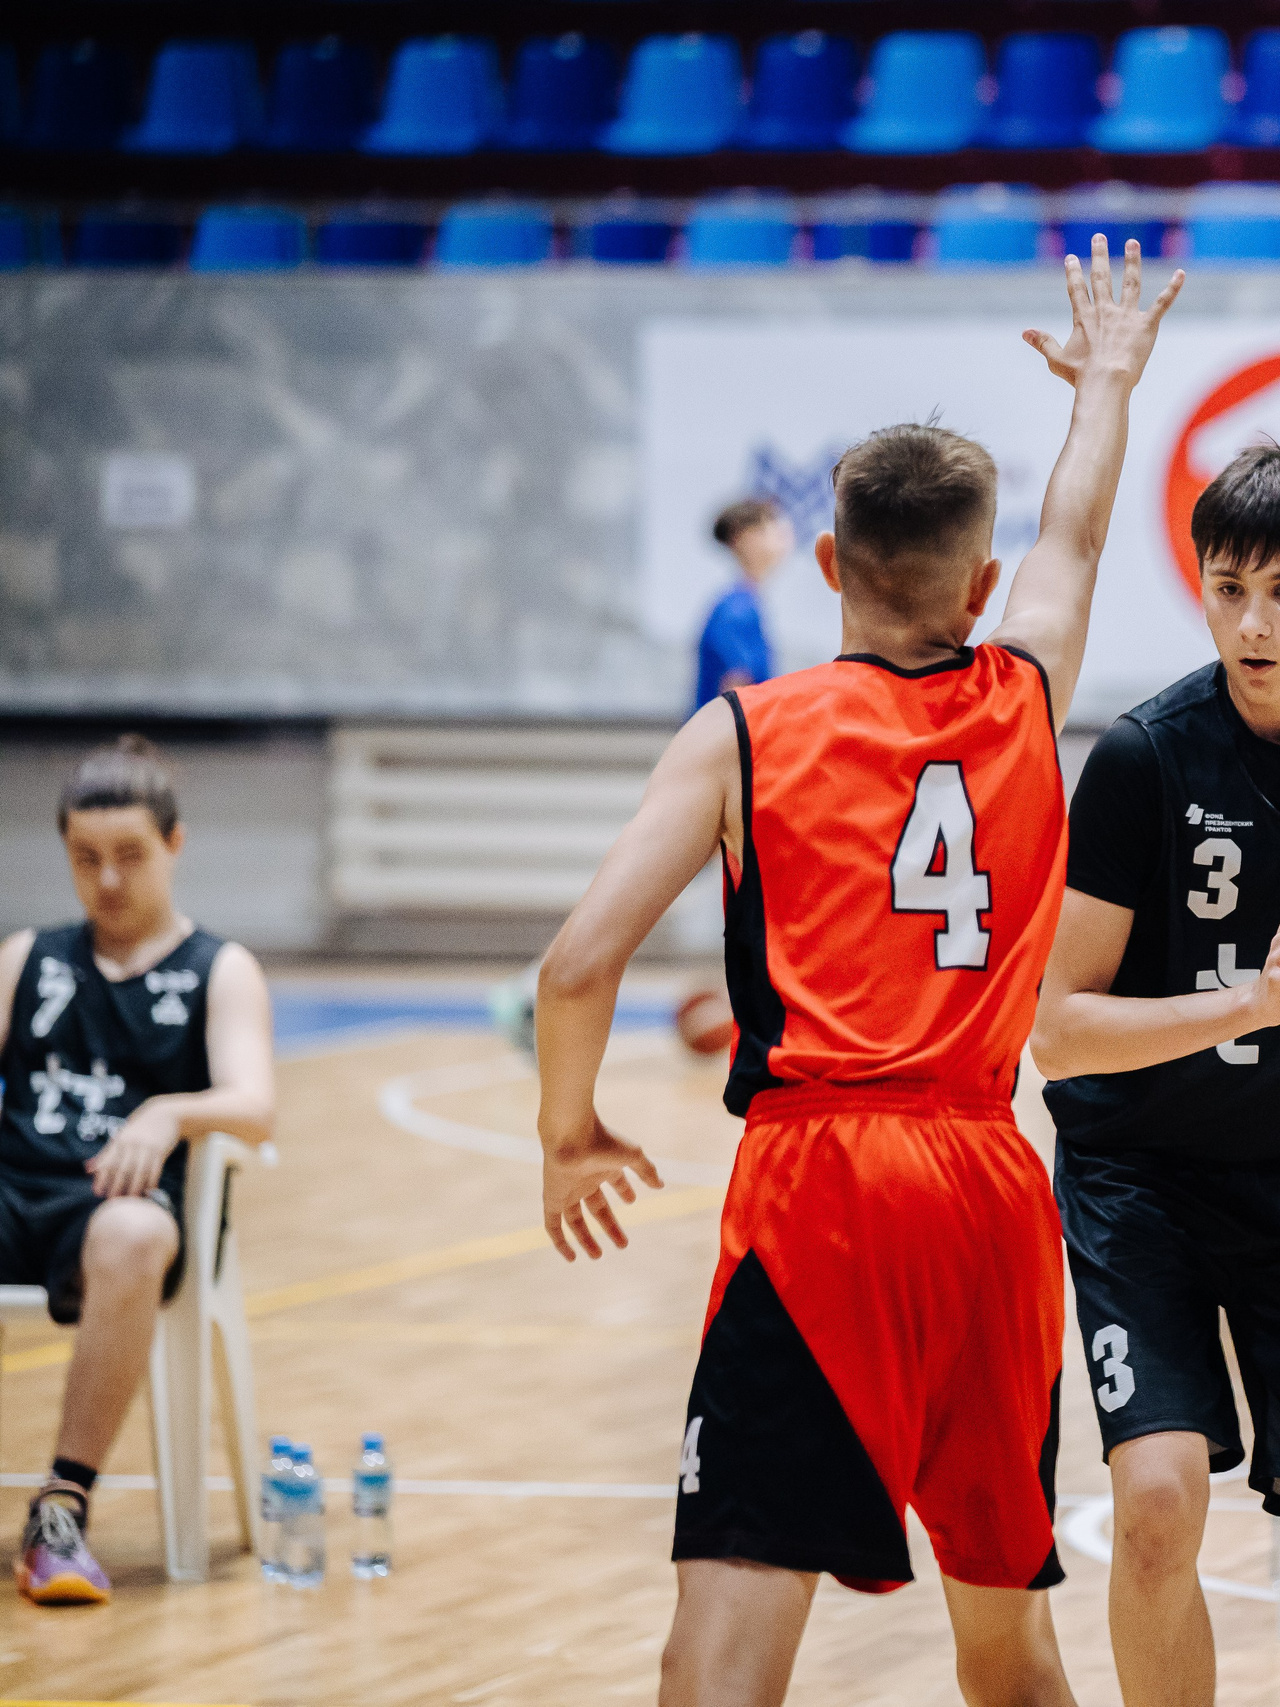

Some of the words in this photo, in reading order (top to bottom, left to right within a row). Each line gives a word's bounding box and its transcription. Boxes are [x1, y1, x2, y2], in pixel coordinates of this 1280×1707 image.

[889, 760, 993, 971] 4
[1187, 838, 1242, 920] 3
[1091, 1323, 1136, 1413] 3
[680, 1415, 704, 1494] 4
